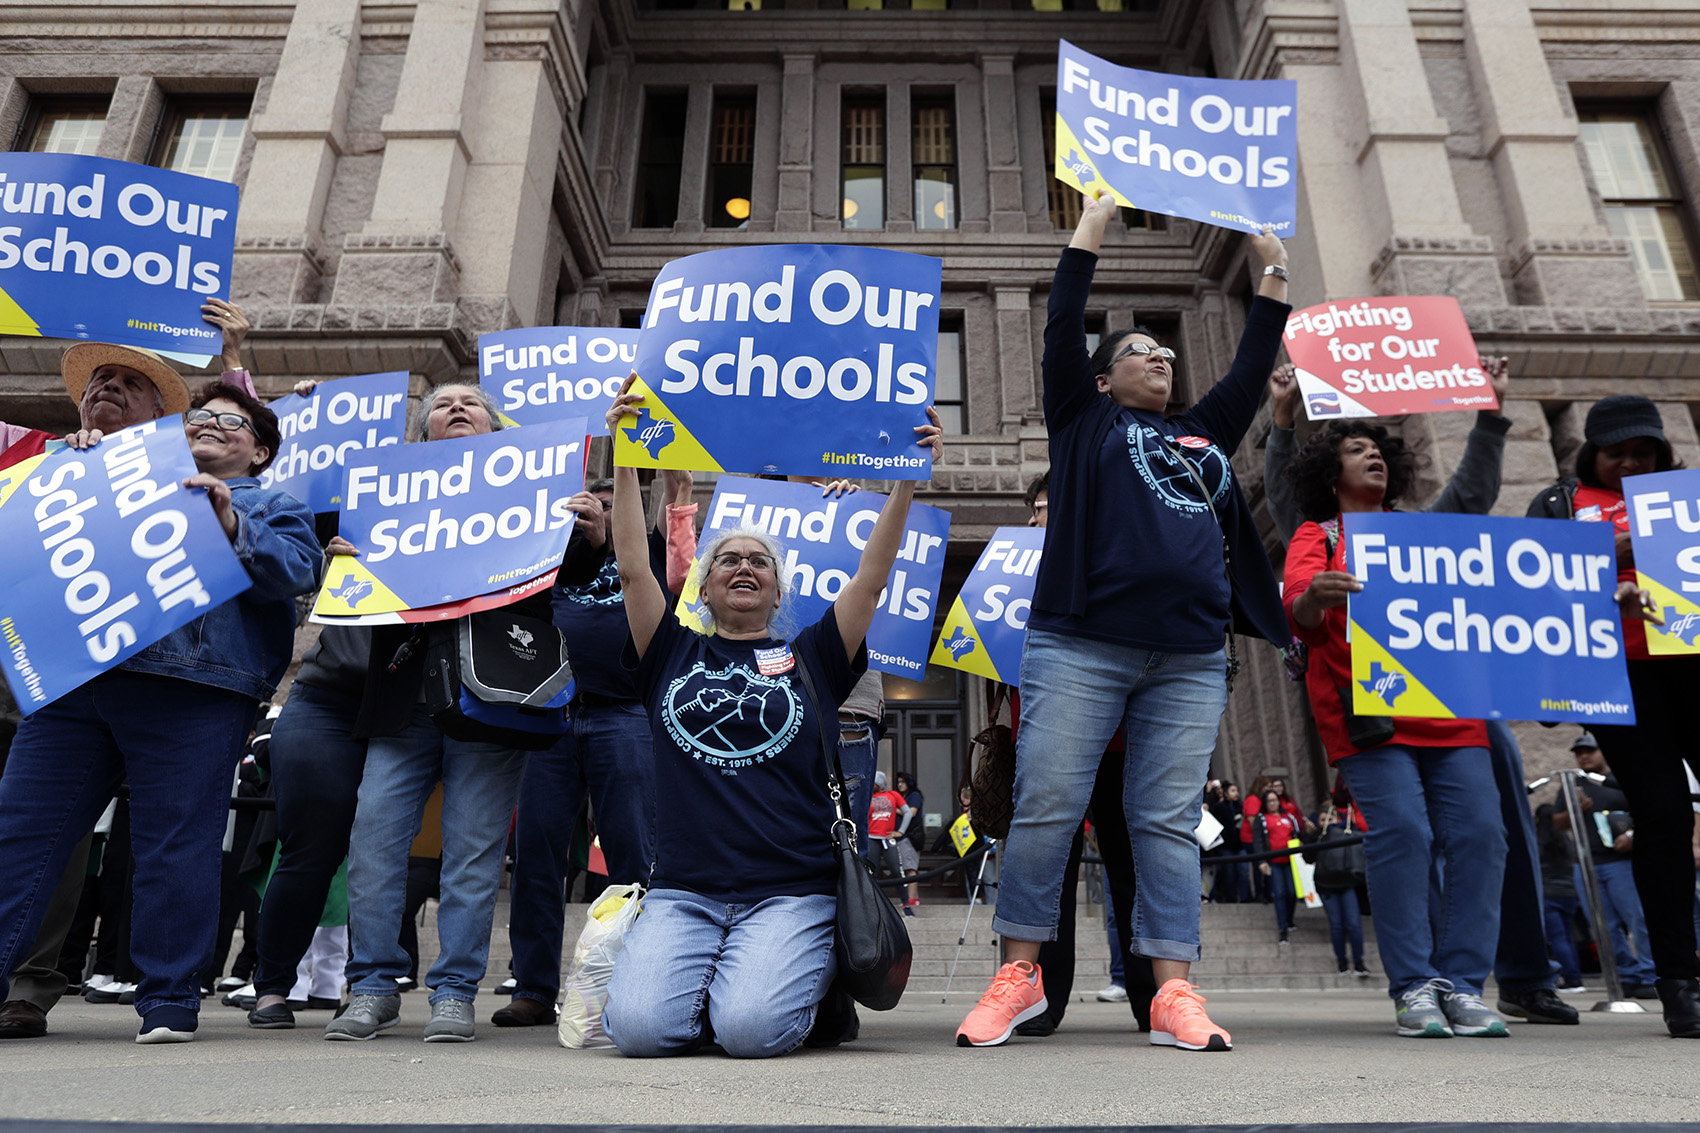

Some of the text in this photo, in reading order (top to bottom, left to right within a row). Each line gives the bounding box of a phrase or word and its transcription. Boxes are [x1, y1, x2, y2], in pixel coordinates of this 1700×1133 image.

[1063, 57, 1292, 136] Fund Our
[1083, 116, 1290, 188] Schools
[117, 183, 228, 239] Our
[1210, 210, 1291, 231] #InItTogeher
[0, 226, 221, 294] Schools
[646, 265, 934, 331] Fund Our
[1284, 302, 1413, 340] Fighting
[127, 319, 217, 339] #InItTogether
[483, 335, 638, 376] Fund Ou
[1327, 335, 1440, 362] for Our
[502, 372, 626, 411] Schoo
[660, 337, 929, 405] Schools
[1341, 363, 1487, 394] Students
[327, 391, 403, 425] Our
[346, 441, 579, 511] Fund Our
[821, 451, 926, 469] #InItTogether
[102, 421, 211, 613] Fund Our
[366, 488, 576, 563] Schools
[28, 461, 140, 664] Schools
[488, 552, 562, 584] #InItTogether
[1352, 533, 1610, 592] Fund Our
[1386, 597, 1619, 659] Schools
[661, 708, 691, 753] CORPUS
[766, 704, 804, 758] TEACHERS
[1540, 698, 1630, 715] #InItTogether
[705, 756, 753, 768] EST. 1976
